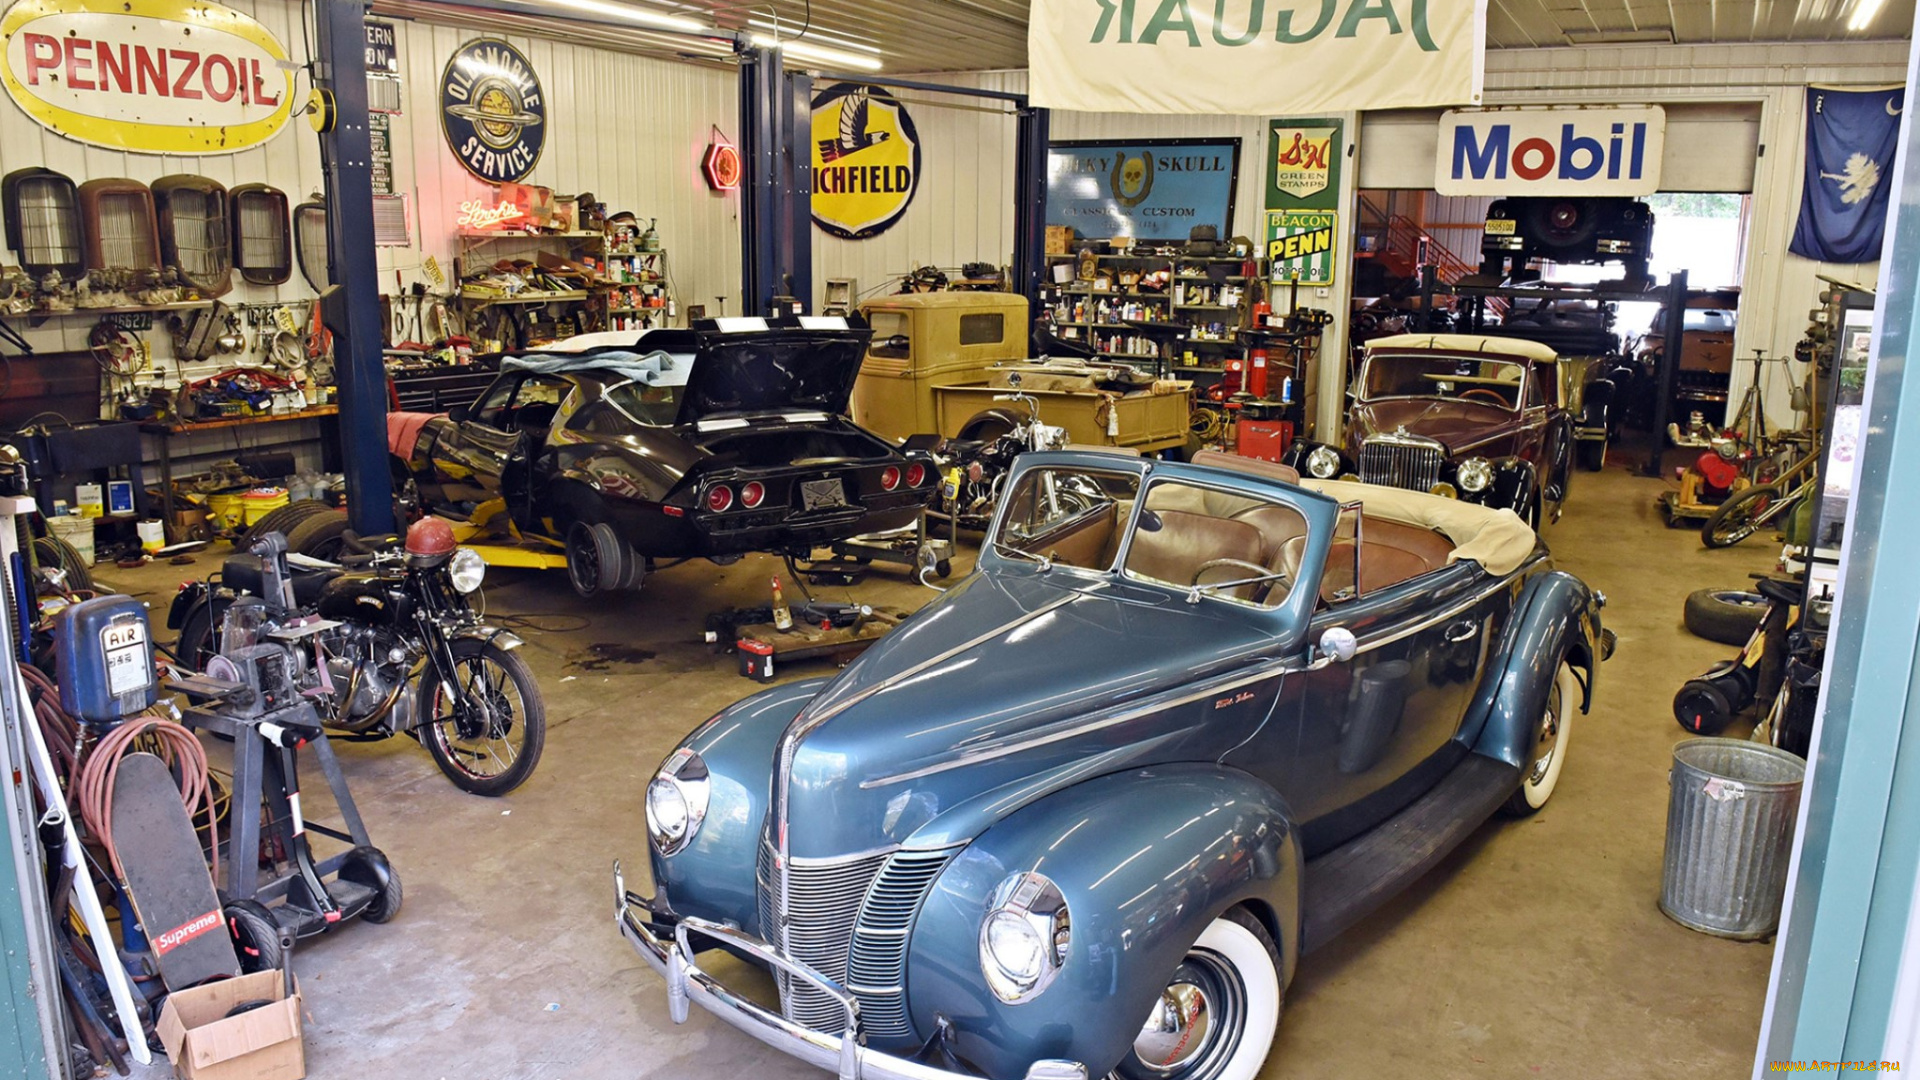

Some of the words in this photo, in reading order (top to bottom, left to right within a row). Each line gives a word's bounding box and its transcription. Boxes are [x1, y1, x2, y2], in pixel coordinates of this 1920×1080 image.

[364, 26, 393, 46] ERN
[23, 32, 279, 107] PENNZOIL
[447, 46, 540, 108] OLDSMOBILE
[461, 136, 533, 179] SERVICE
[1451, 122, 1647, 180] Mobil
[1157, 156, 1226, 172] SKULL
[1280, 172, 1325, 180] GREEN
[813, 165, 911, 194] ICHFIELD
[1279, 180, 1325, 188] STAMPS
[1142, 207, 1196, 217] CUSTOM
[1271, 215, 1331, 227] BEACON
[1269, 229, 1330, 262] PENN
[104, 628, 136, 645] AIR
[159, 914, 217, 949] Supreme
